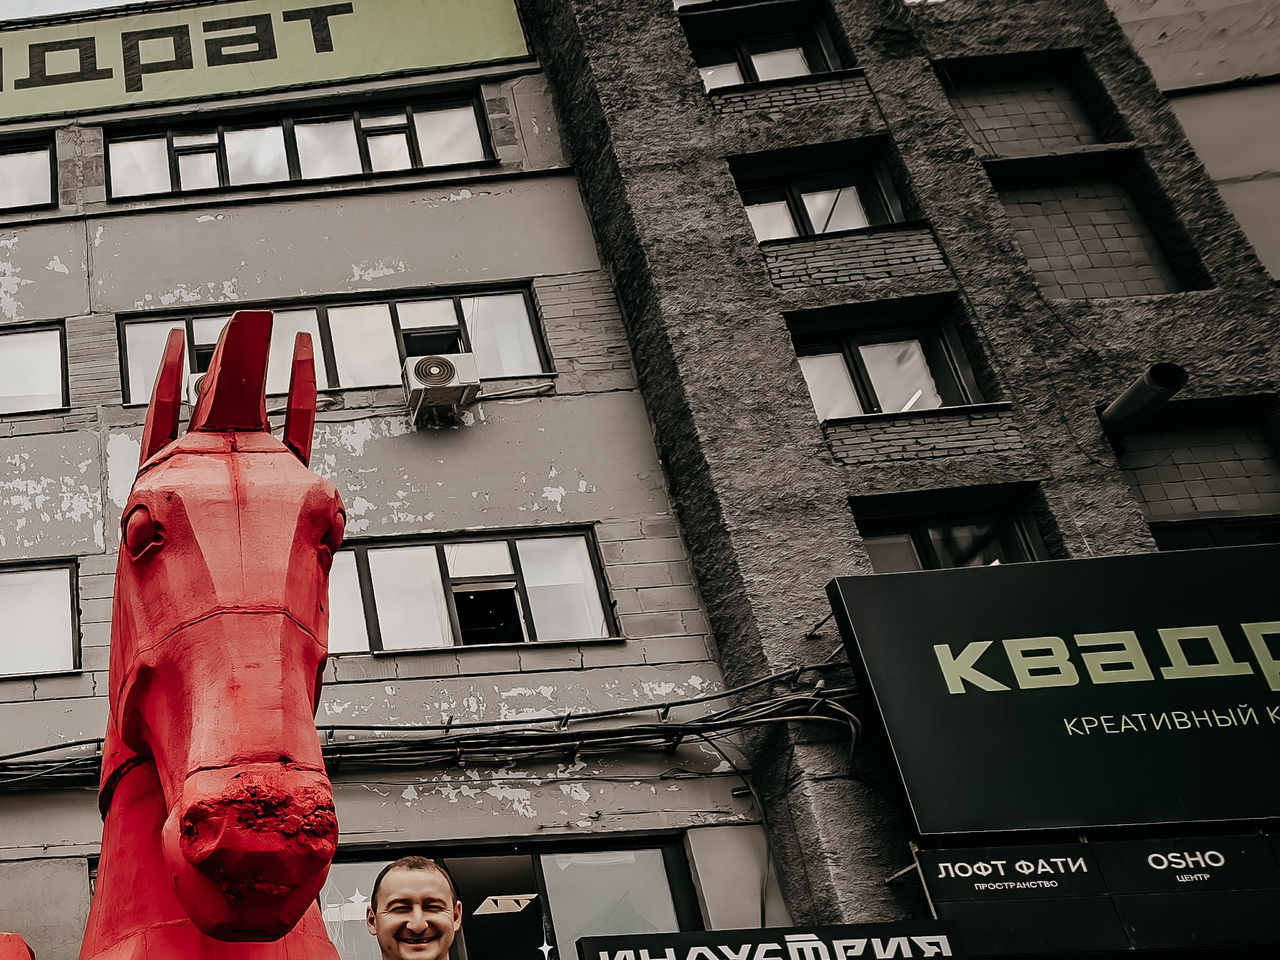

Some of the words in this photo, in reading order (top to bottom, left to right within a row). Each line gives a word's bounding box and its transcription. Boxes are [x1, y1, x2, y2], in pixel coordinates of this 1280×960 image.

[1062, 704, 1260, 737] КРЕАТИВНЫЙ
[937, 860, 1007, 879] ЛОФТ
[1014, 857, 1089, 875] ФАТИ
[1147, 850, 1226, 870] OSHO
[974, 880, 1059, 891] ПРОСТРАНСТВО
[1176, 873, 1211, 883] ЦЕНТР
